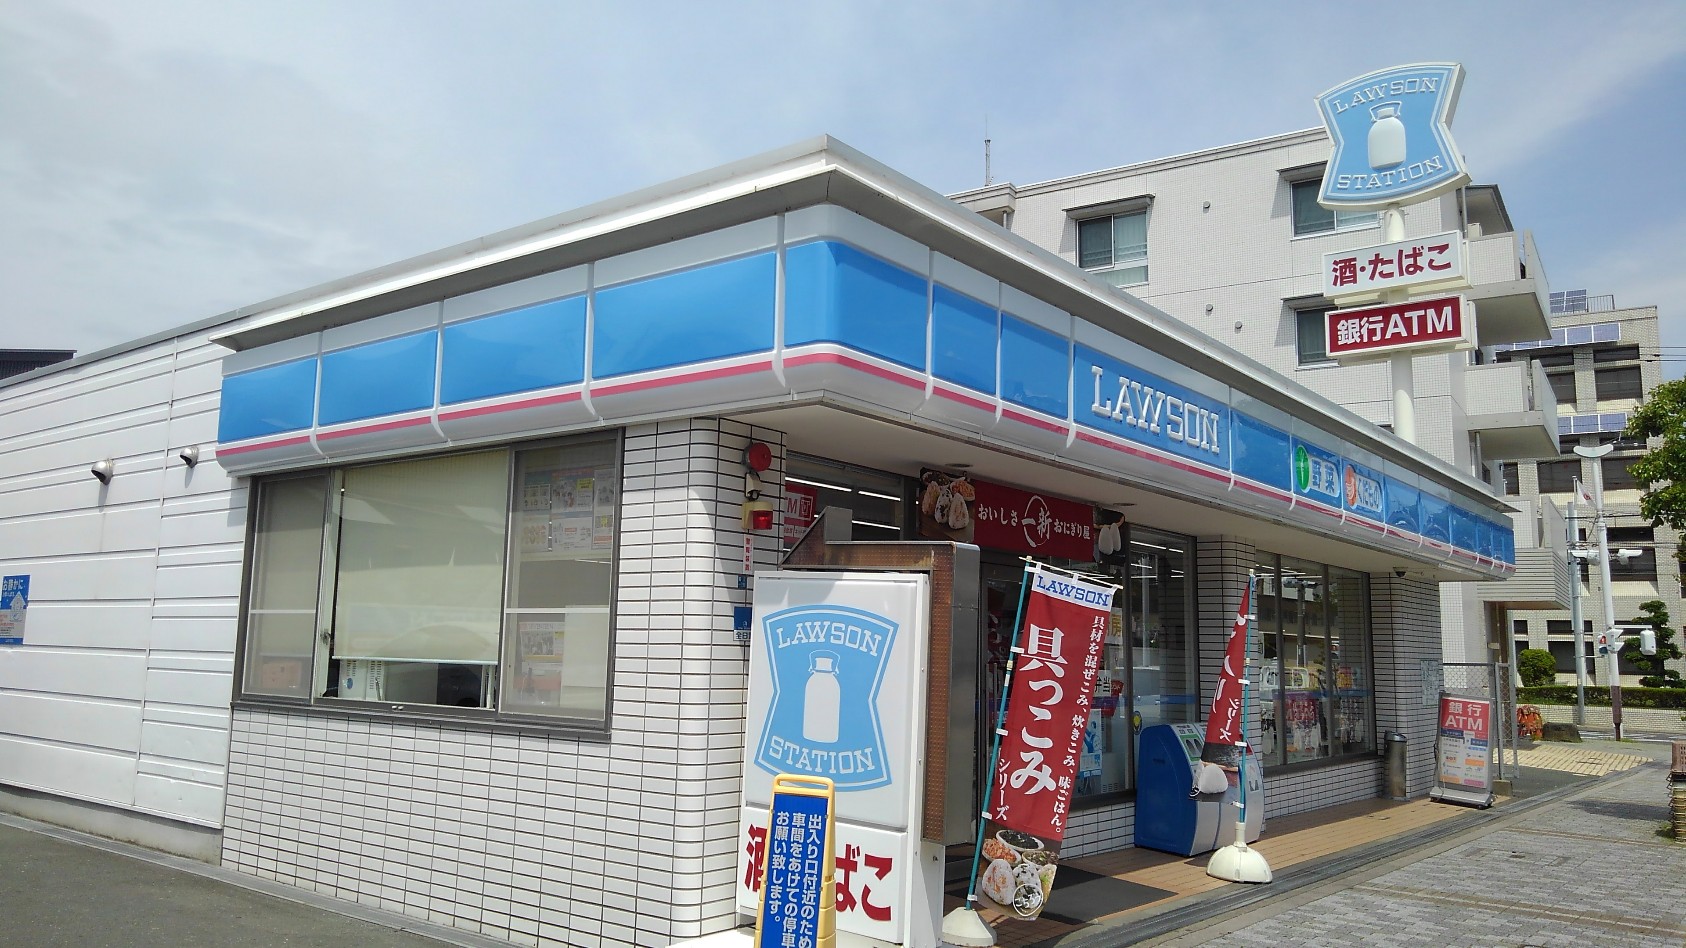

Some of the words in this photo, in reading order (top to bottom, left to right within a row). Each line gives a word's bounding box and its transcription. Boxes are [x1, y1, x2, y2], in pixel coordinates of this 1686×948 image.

[1333, 77, 1439, 114] LAWSON
[1336, 155, 1443, 190] STATION
[1332, 243, 1451, 287] 酒・たばこ
[1337, 305, 1453, 346] 銀行ATM
[1091, 365, 1220, 454] LAWSON
[978, 503, 1018, 526] おいしさ
[1054, 518, 1091, 540] おにぎり屋
[1036, 575, 1110, 607] LAWSON
[776, 620, 882, 657] LAWSON
[1445, 714, 1483, 731] ATM
[1448, 702, 1482, 717] 銀行
[768, 735, 876, 774] STATION
[995, 758, 1011, 821] シリーズ
[768, 811, 790, 923] お願い致します。
[781, 812, 806, 948] 車間をあけての停車
[798, 813, 822, 948] 出入り口付近のため
